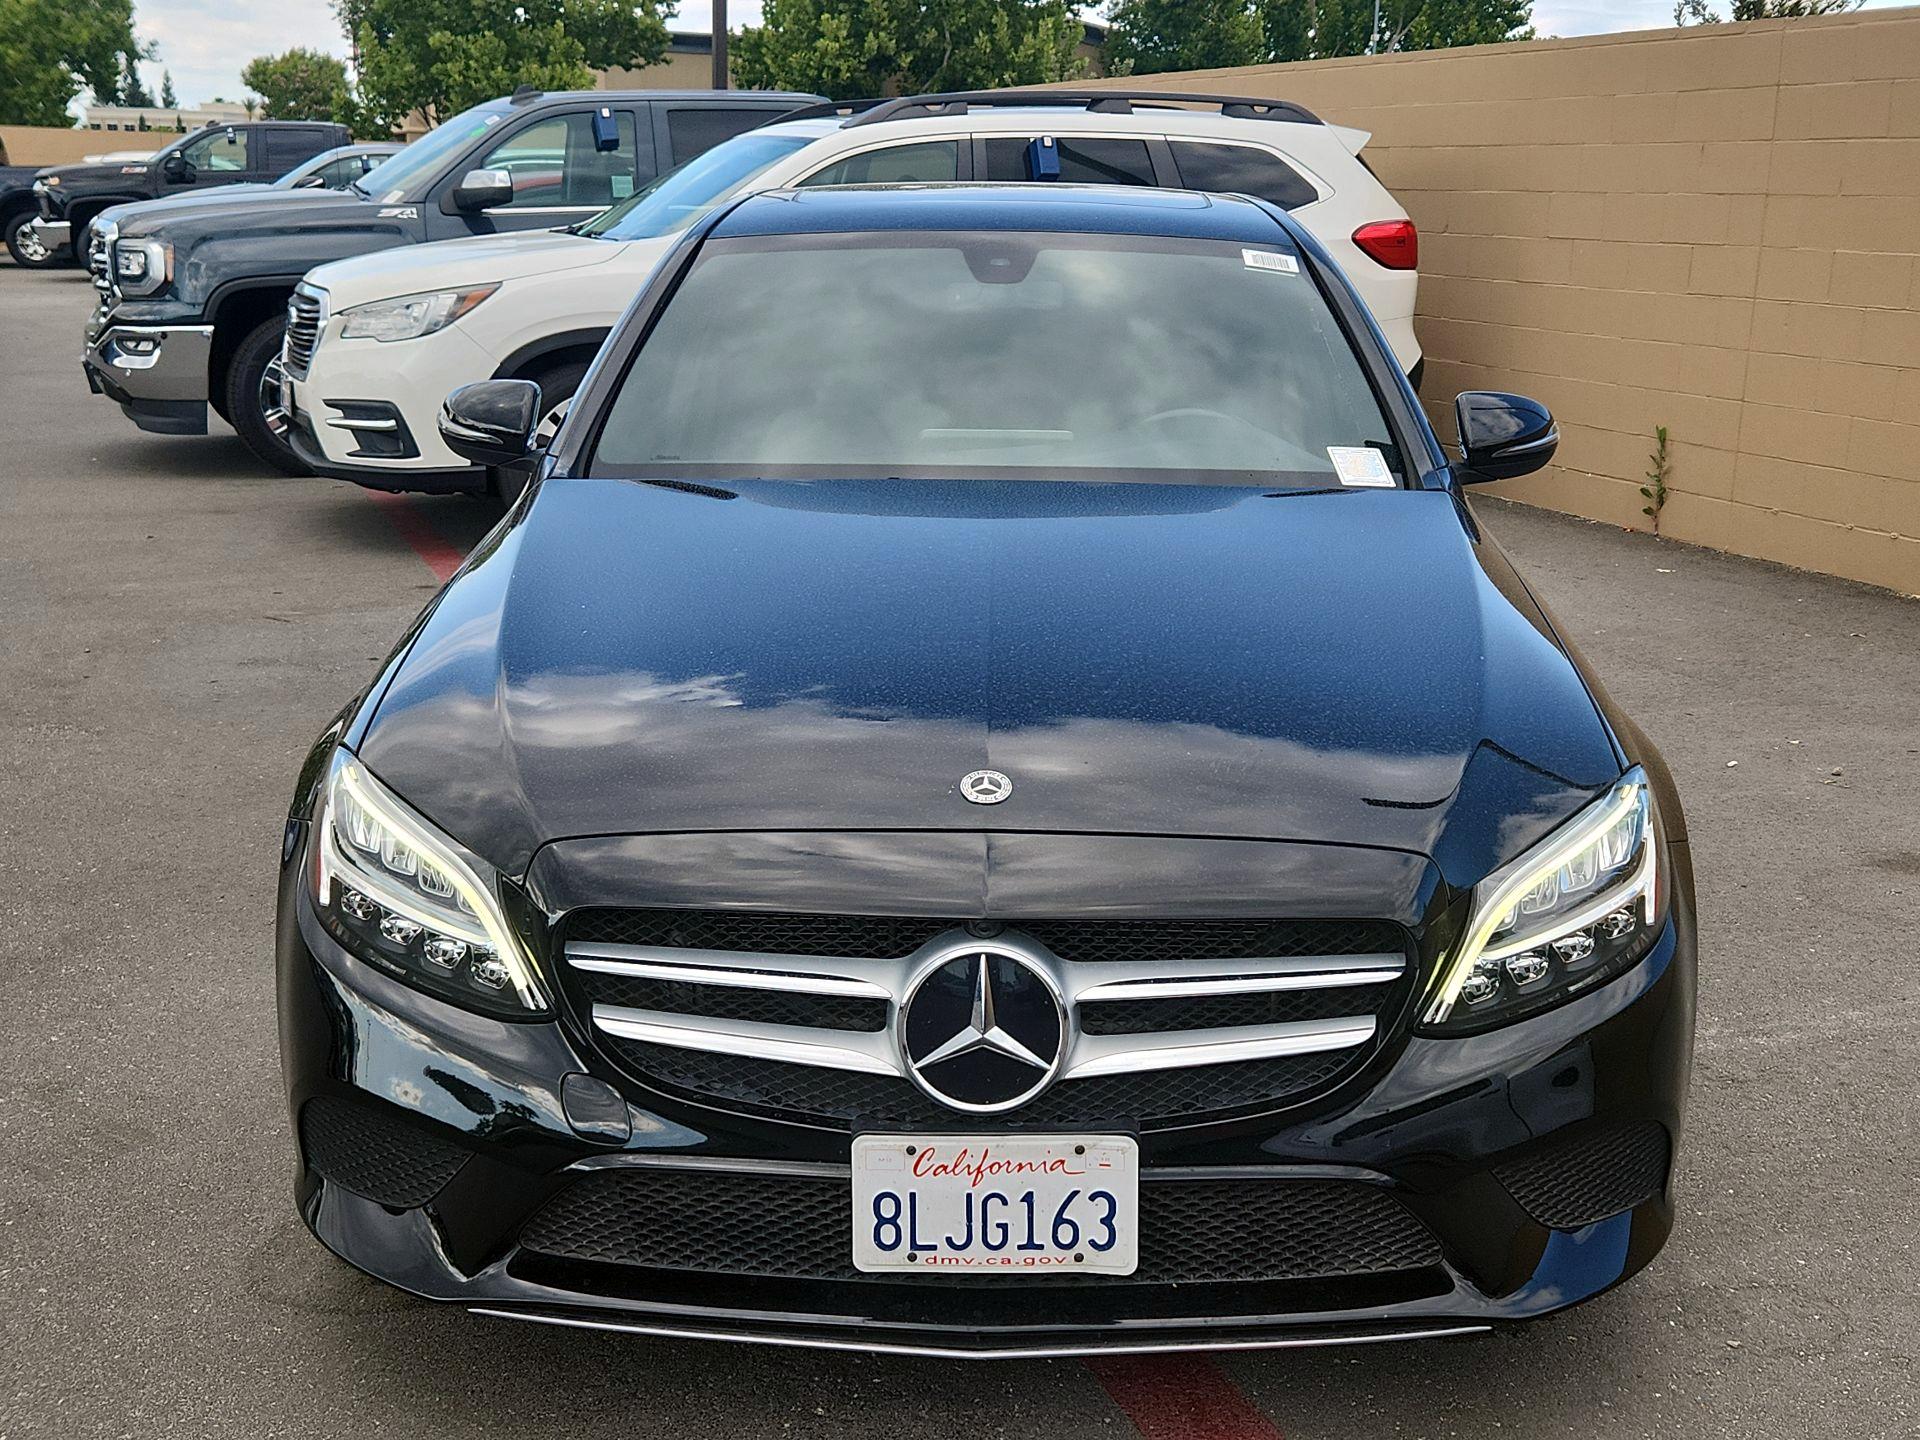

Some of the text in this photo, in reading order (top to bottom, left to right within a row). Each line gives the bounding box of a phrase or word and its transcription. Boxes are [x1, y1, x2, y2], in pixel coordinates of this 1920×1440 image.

[912, 1146, 1085, 1187] California
[872, 1189, 1117, 1252] 8LJG163
[924, 1255, 1067, 1267] dmv.ca.gov
